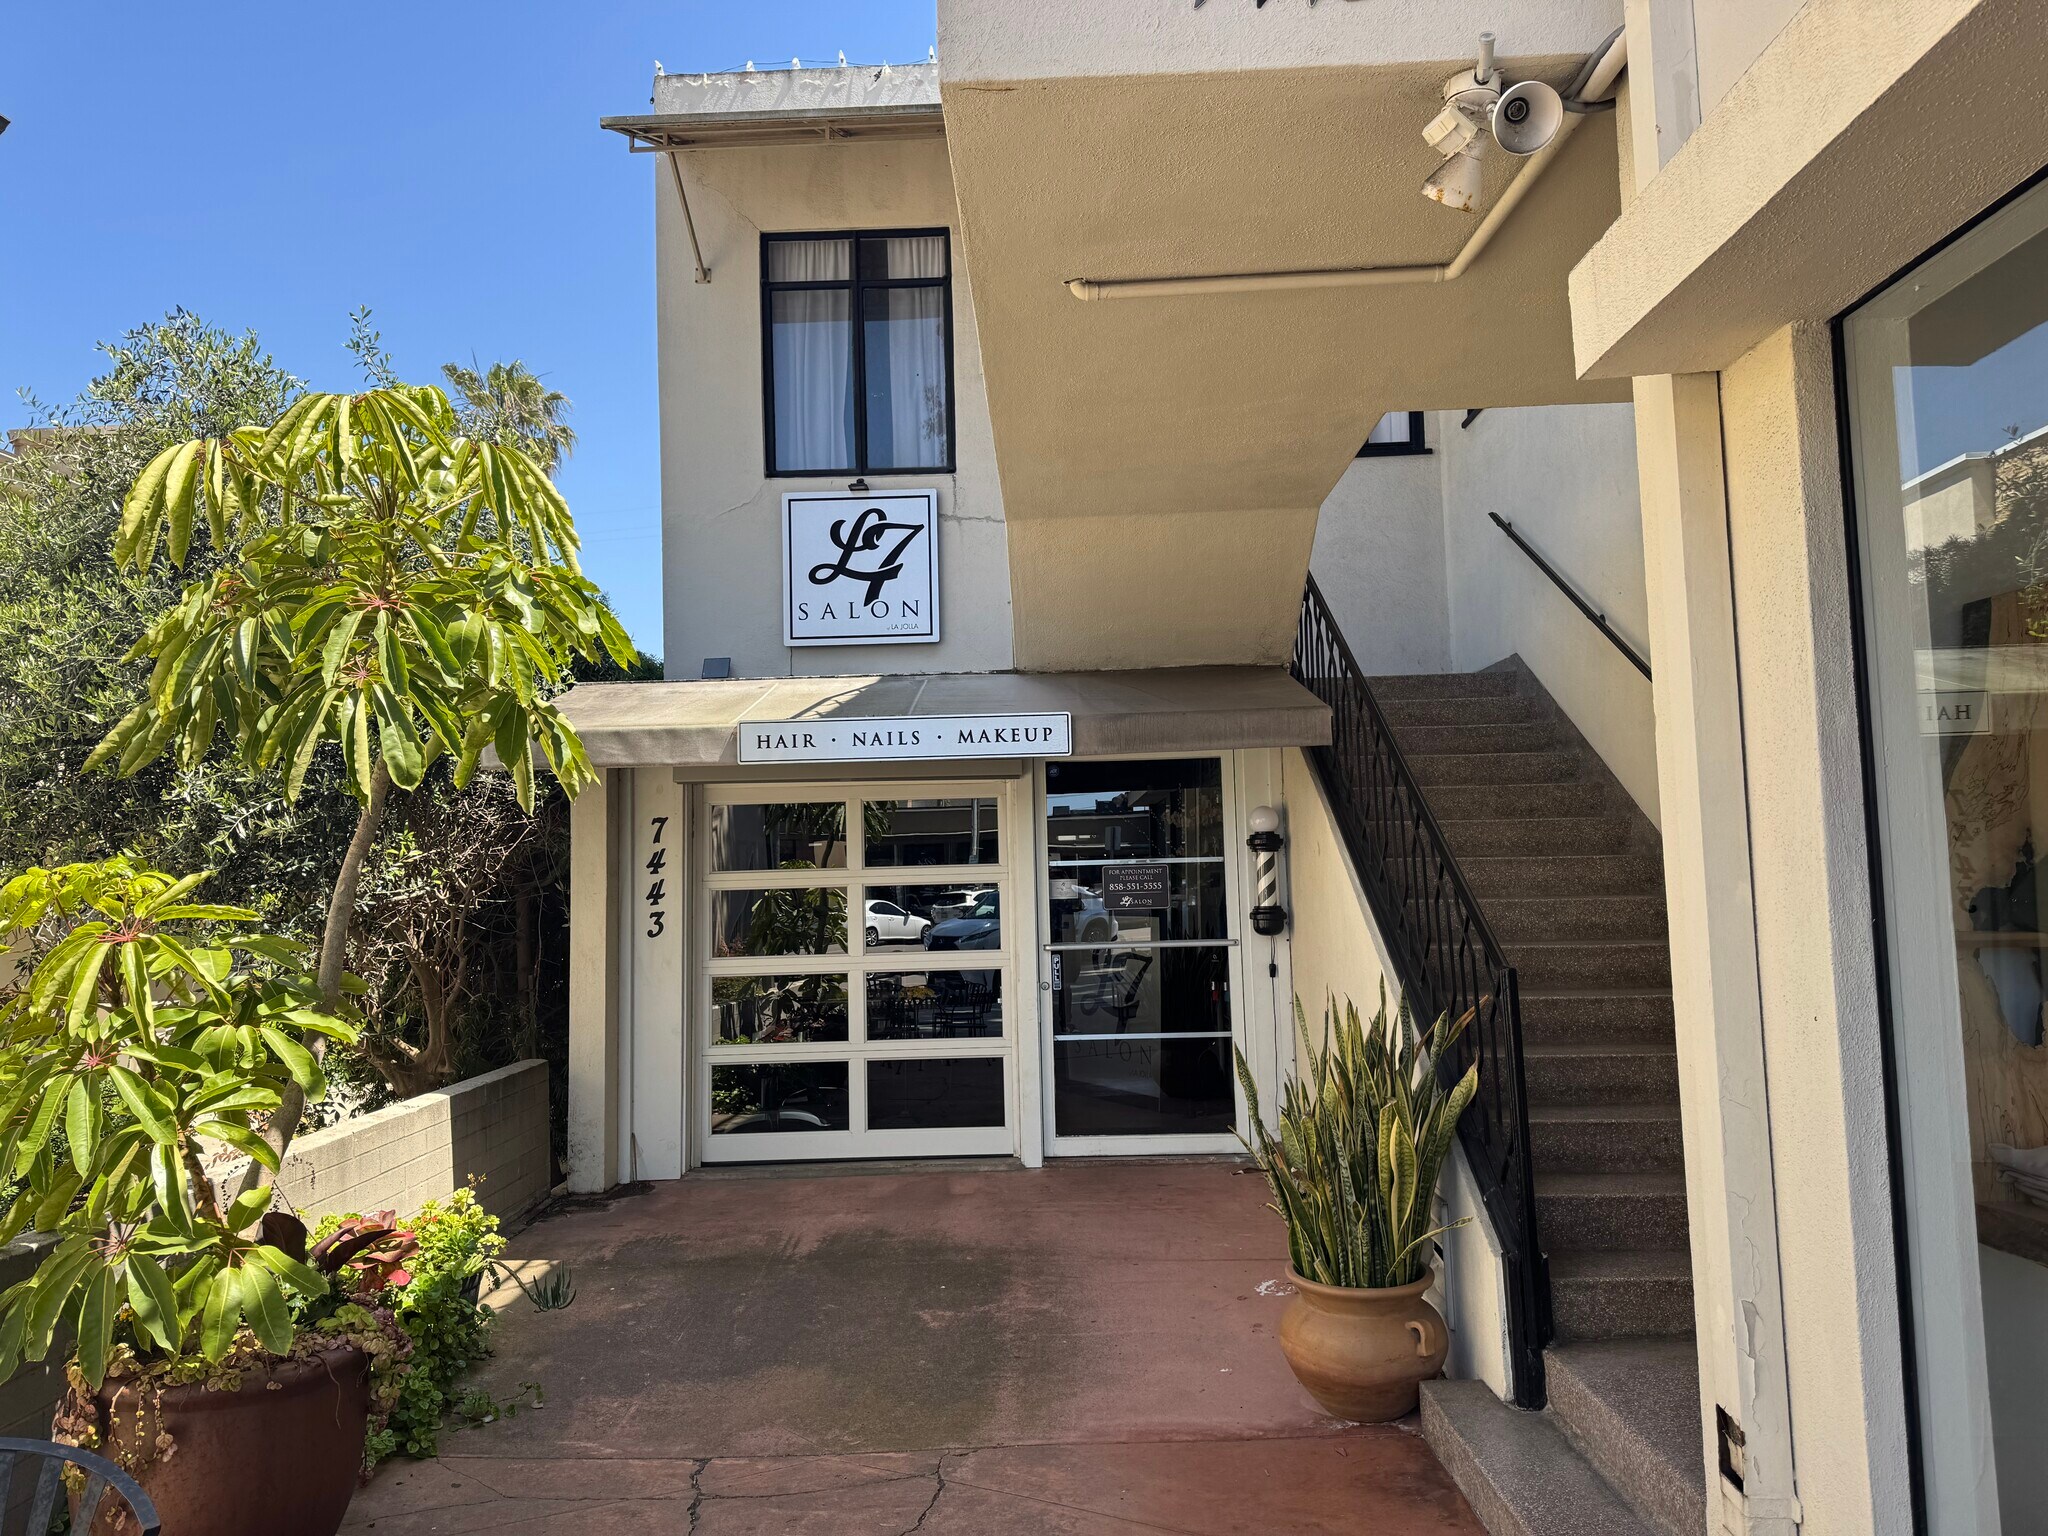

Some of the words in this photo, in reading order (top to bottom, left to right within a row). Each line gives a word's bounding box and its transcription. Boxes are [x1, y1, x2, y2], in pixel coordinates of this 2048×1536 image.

[798, 600, 920, 621] SALON
[900, 622, 919, 631] JOLLA
[756, 733, 817, 750] HAIR
[852, 730, 920, 747] NAILS
[957, 727, 1053, 744] MAKEUP
[645, 816, 669, 938] 7443
[1109, 882, 1162, 890] 858-551-5555
[1075, 1040, 1152, 1065] SALON
